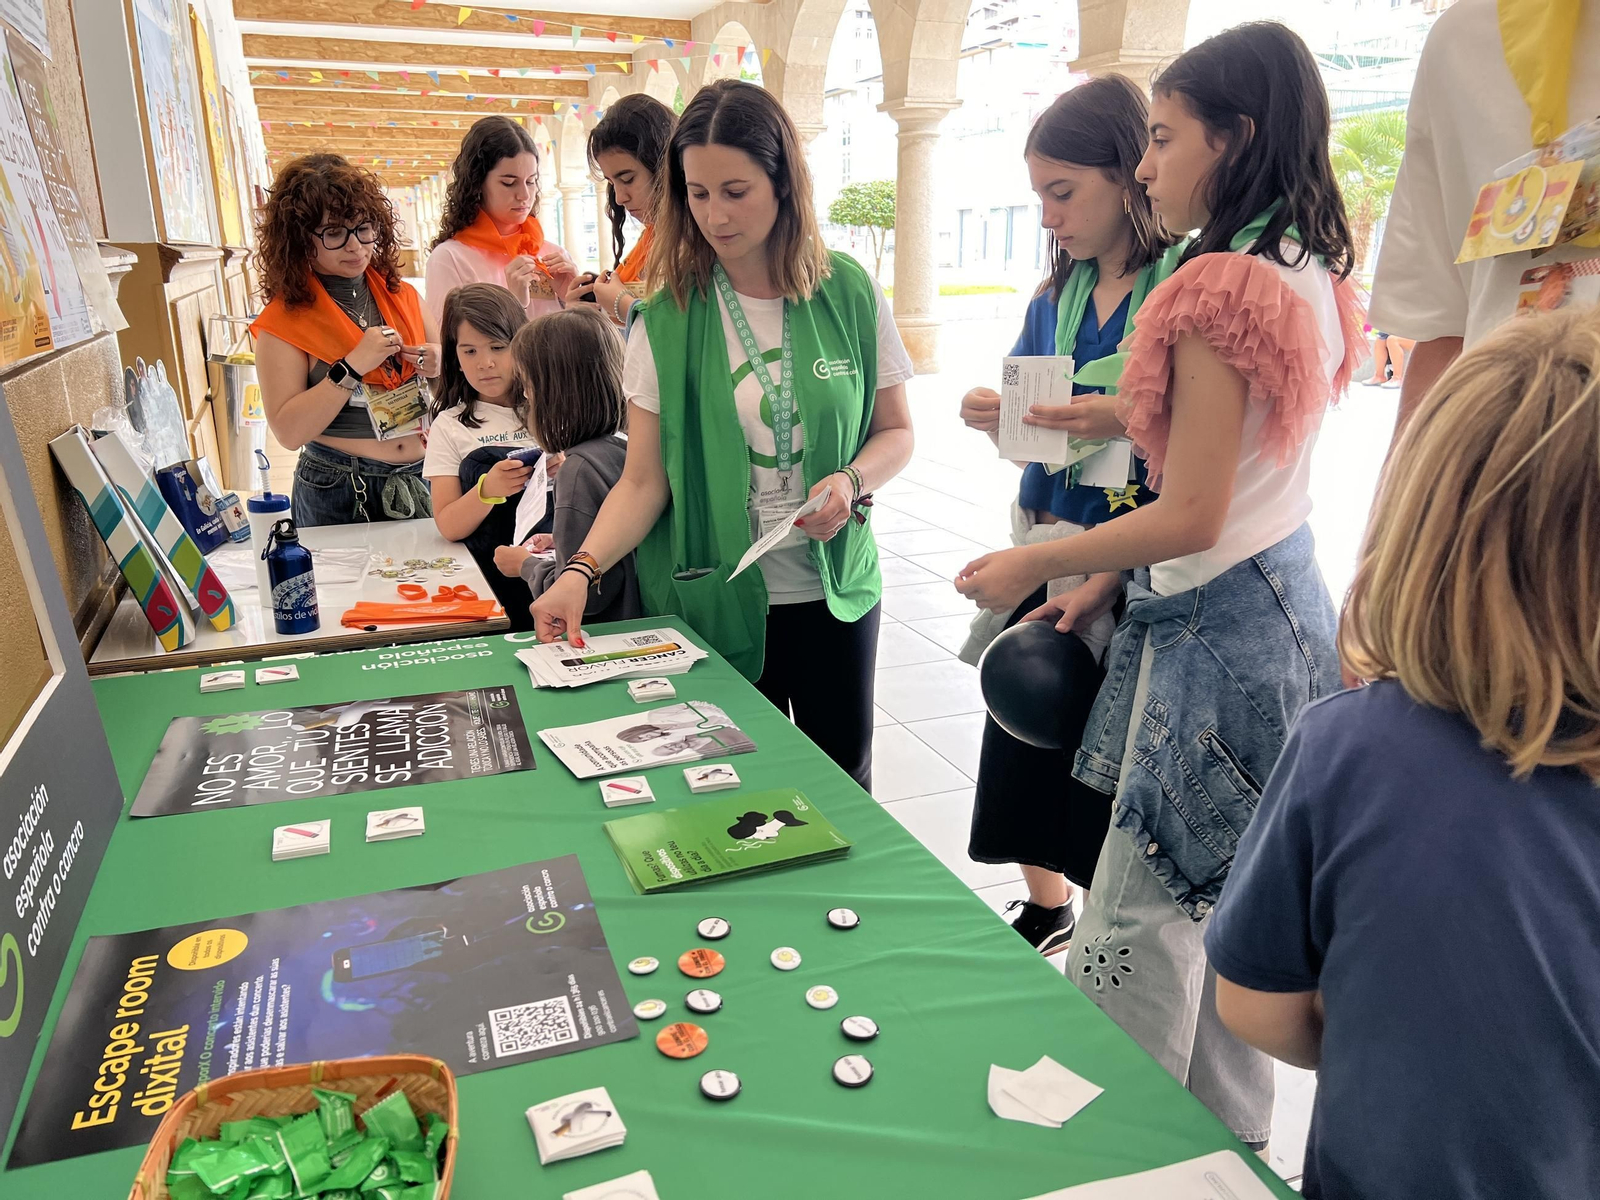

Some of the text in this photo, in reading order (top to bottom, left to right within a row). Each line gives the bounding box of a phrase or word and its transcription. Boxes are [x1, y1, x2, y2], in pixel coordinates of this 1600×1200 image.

[477, 431, 528, 444] MARCHÉ AUX
[294, 610, 307, 620] de
[361, 650, 493, 670] asociación
[379, 642, 489, 660] española
[629, 649, 686, 663] CANCER
[568, 659, 626, 673] FLAVOR
[258, 711, 294, 730] LO
[331, 723, 370, 785] SIENTES
[374, 708, 411, 784] SE LLAMA
[191, 753, 244, 806] NO ES
[285, 757, 327, 794] QUE
[3, 783, 49, 880] asociación
[15, 828, 55, 919] española
[541, 869, 552, 887] cancro
[27, 820, 84, 957] contra o cancro
[521, 884, 535, 913] asociación
[533, 886, 547, 910] española
[547, 890, 558, 908] contra
[208, 979, 225, 1014] intervido
[234, 981, 249, 1016] intentando
[263, 979, 277, 1026] desenmascarar
[270, 971, 278, 980] as
[278, 984, 291, 1018] asistentes?
[249, 1003, 260, 1017] dun
[204, 1013, 219, 1050] concerto
[245, 1017, 259, 1052] asistentes
[279, 1018, 288, 1031] aos
[71, 954, 160, 1130] Escape room
[275, 1032, 287, 1052] salvar
[465, 1031, 477, 1056] aventura
[478, 1036, 490, 1061] comeza
[200, 1051, 212, 1060] O
[244, 1051, 254, 1065] aos
[132, 1024, 190, 1116] dixital
